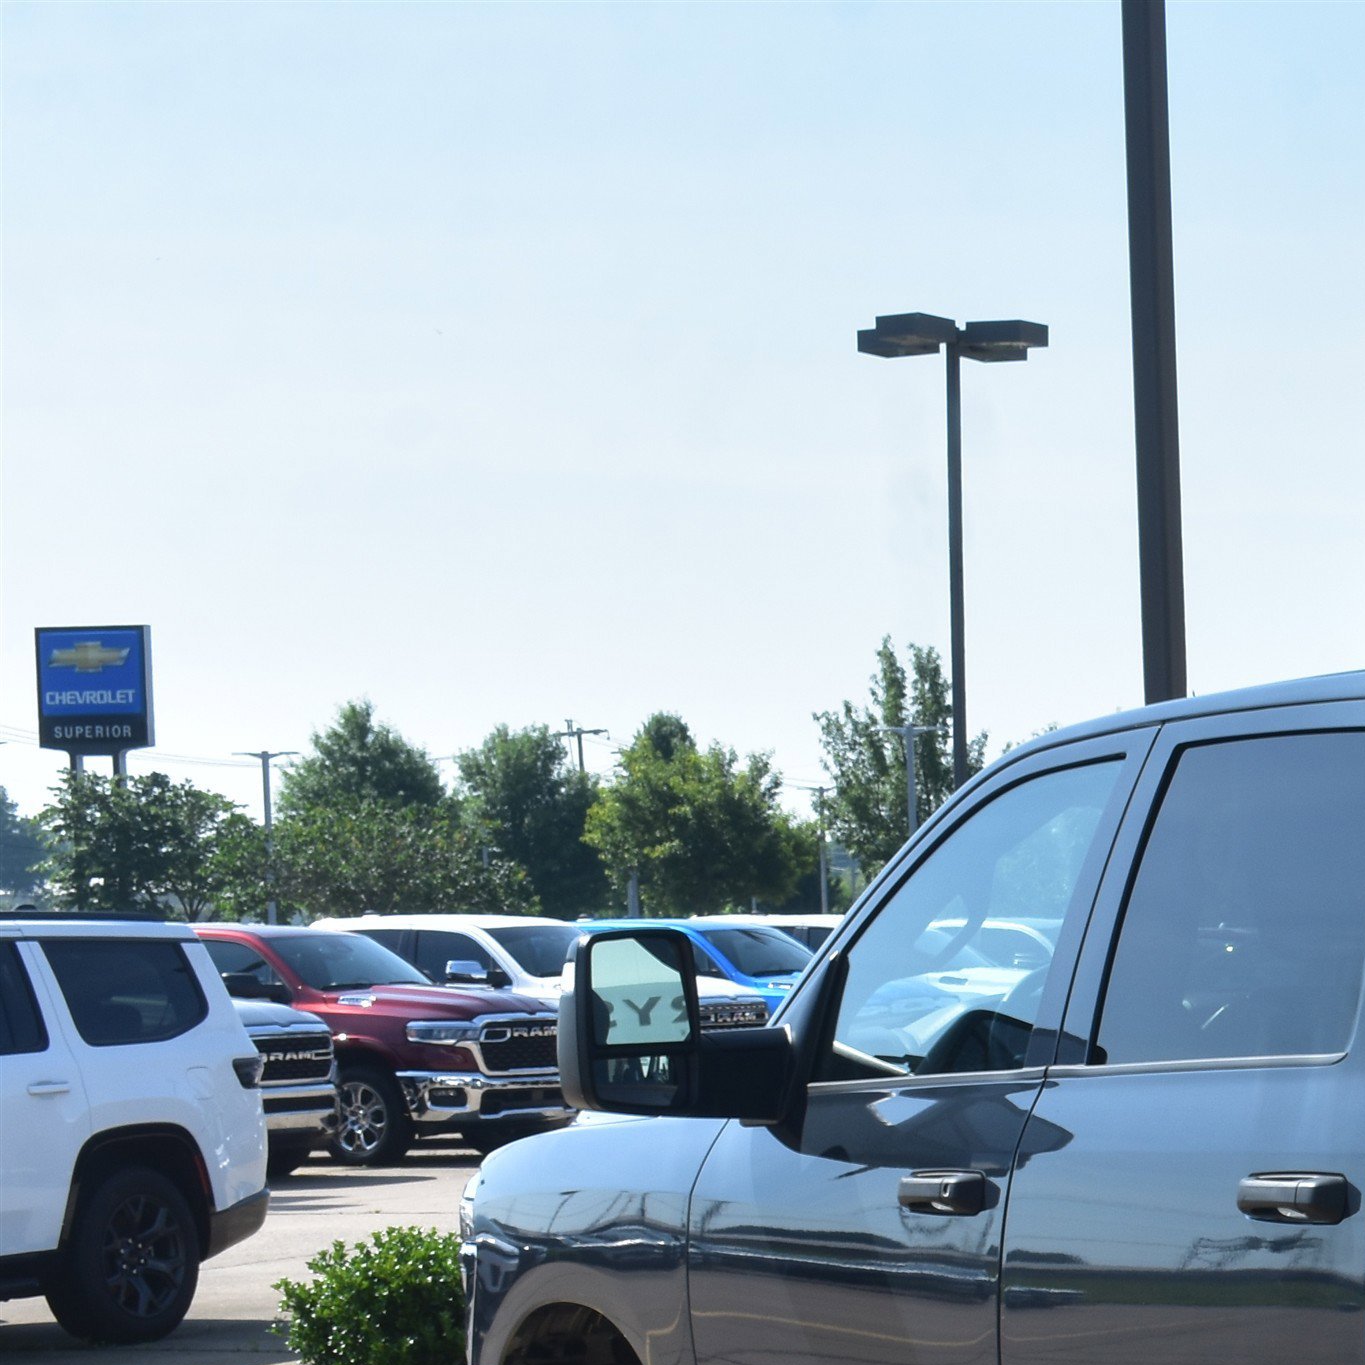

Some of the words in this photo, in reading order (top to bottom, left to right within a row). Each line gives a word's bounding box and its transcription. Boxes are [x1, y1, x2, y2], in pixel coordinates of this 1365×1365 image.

[46, 689, 136, 705] CHEVROLET
[54, 725, 132, 738] SUPERIOR
[512, 1026, 558, 1037] RAM
[269, 1051, 311, 1061] RAM
